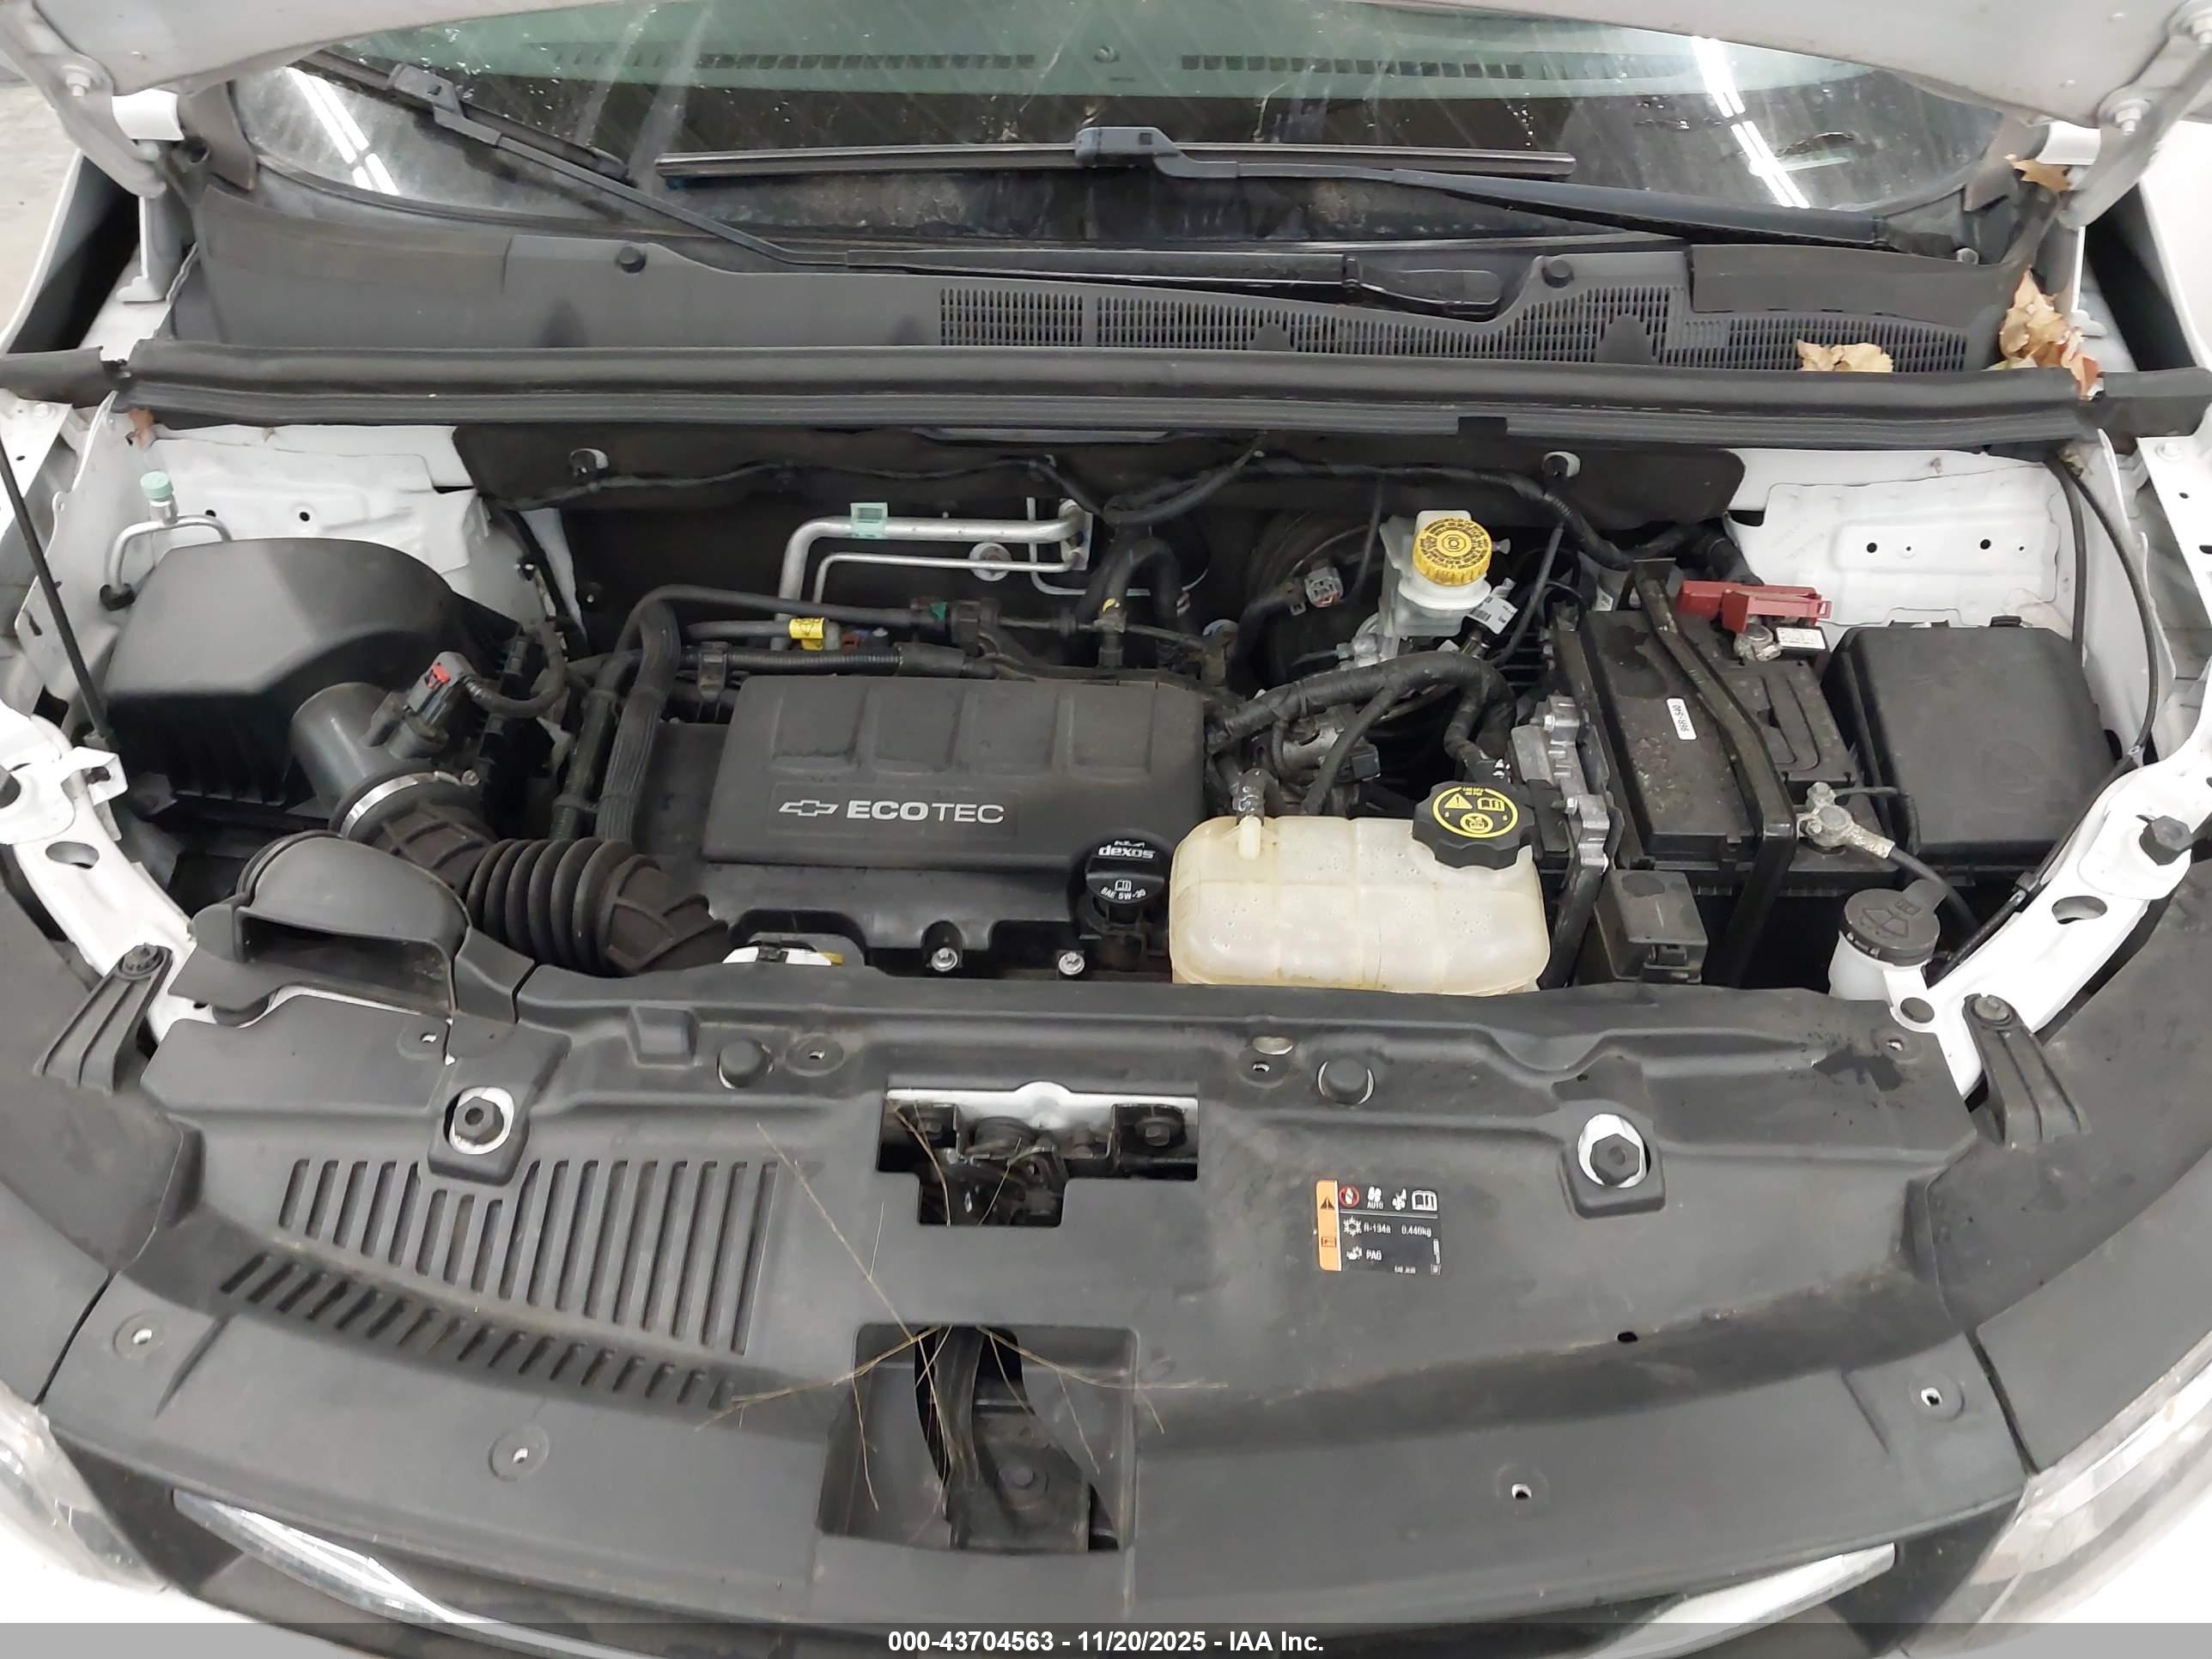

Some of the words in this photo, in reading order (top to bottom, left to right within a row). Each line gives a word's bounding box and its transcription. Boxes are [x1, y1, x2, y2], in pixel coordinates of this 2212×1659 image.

[846, 799, 1005, 824] ECOTEC
[1098, 845, 1156, 860] dexos
[1367, 1200, 1384, 1210] AUTO
